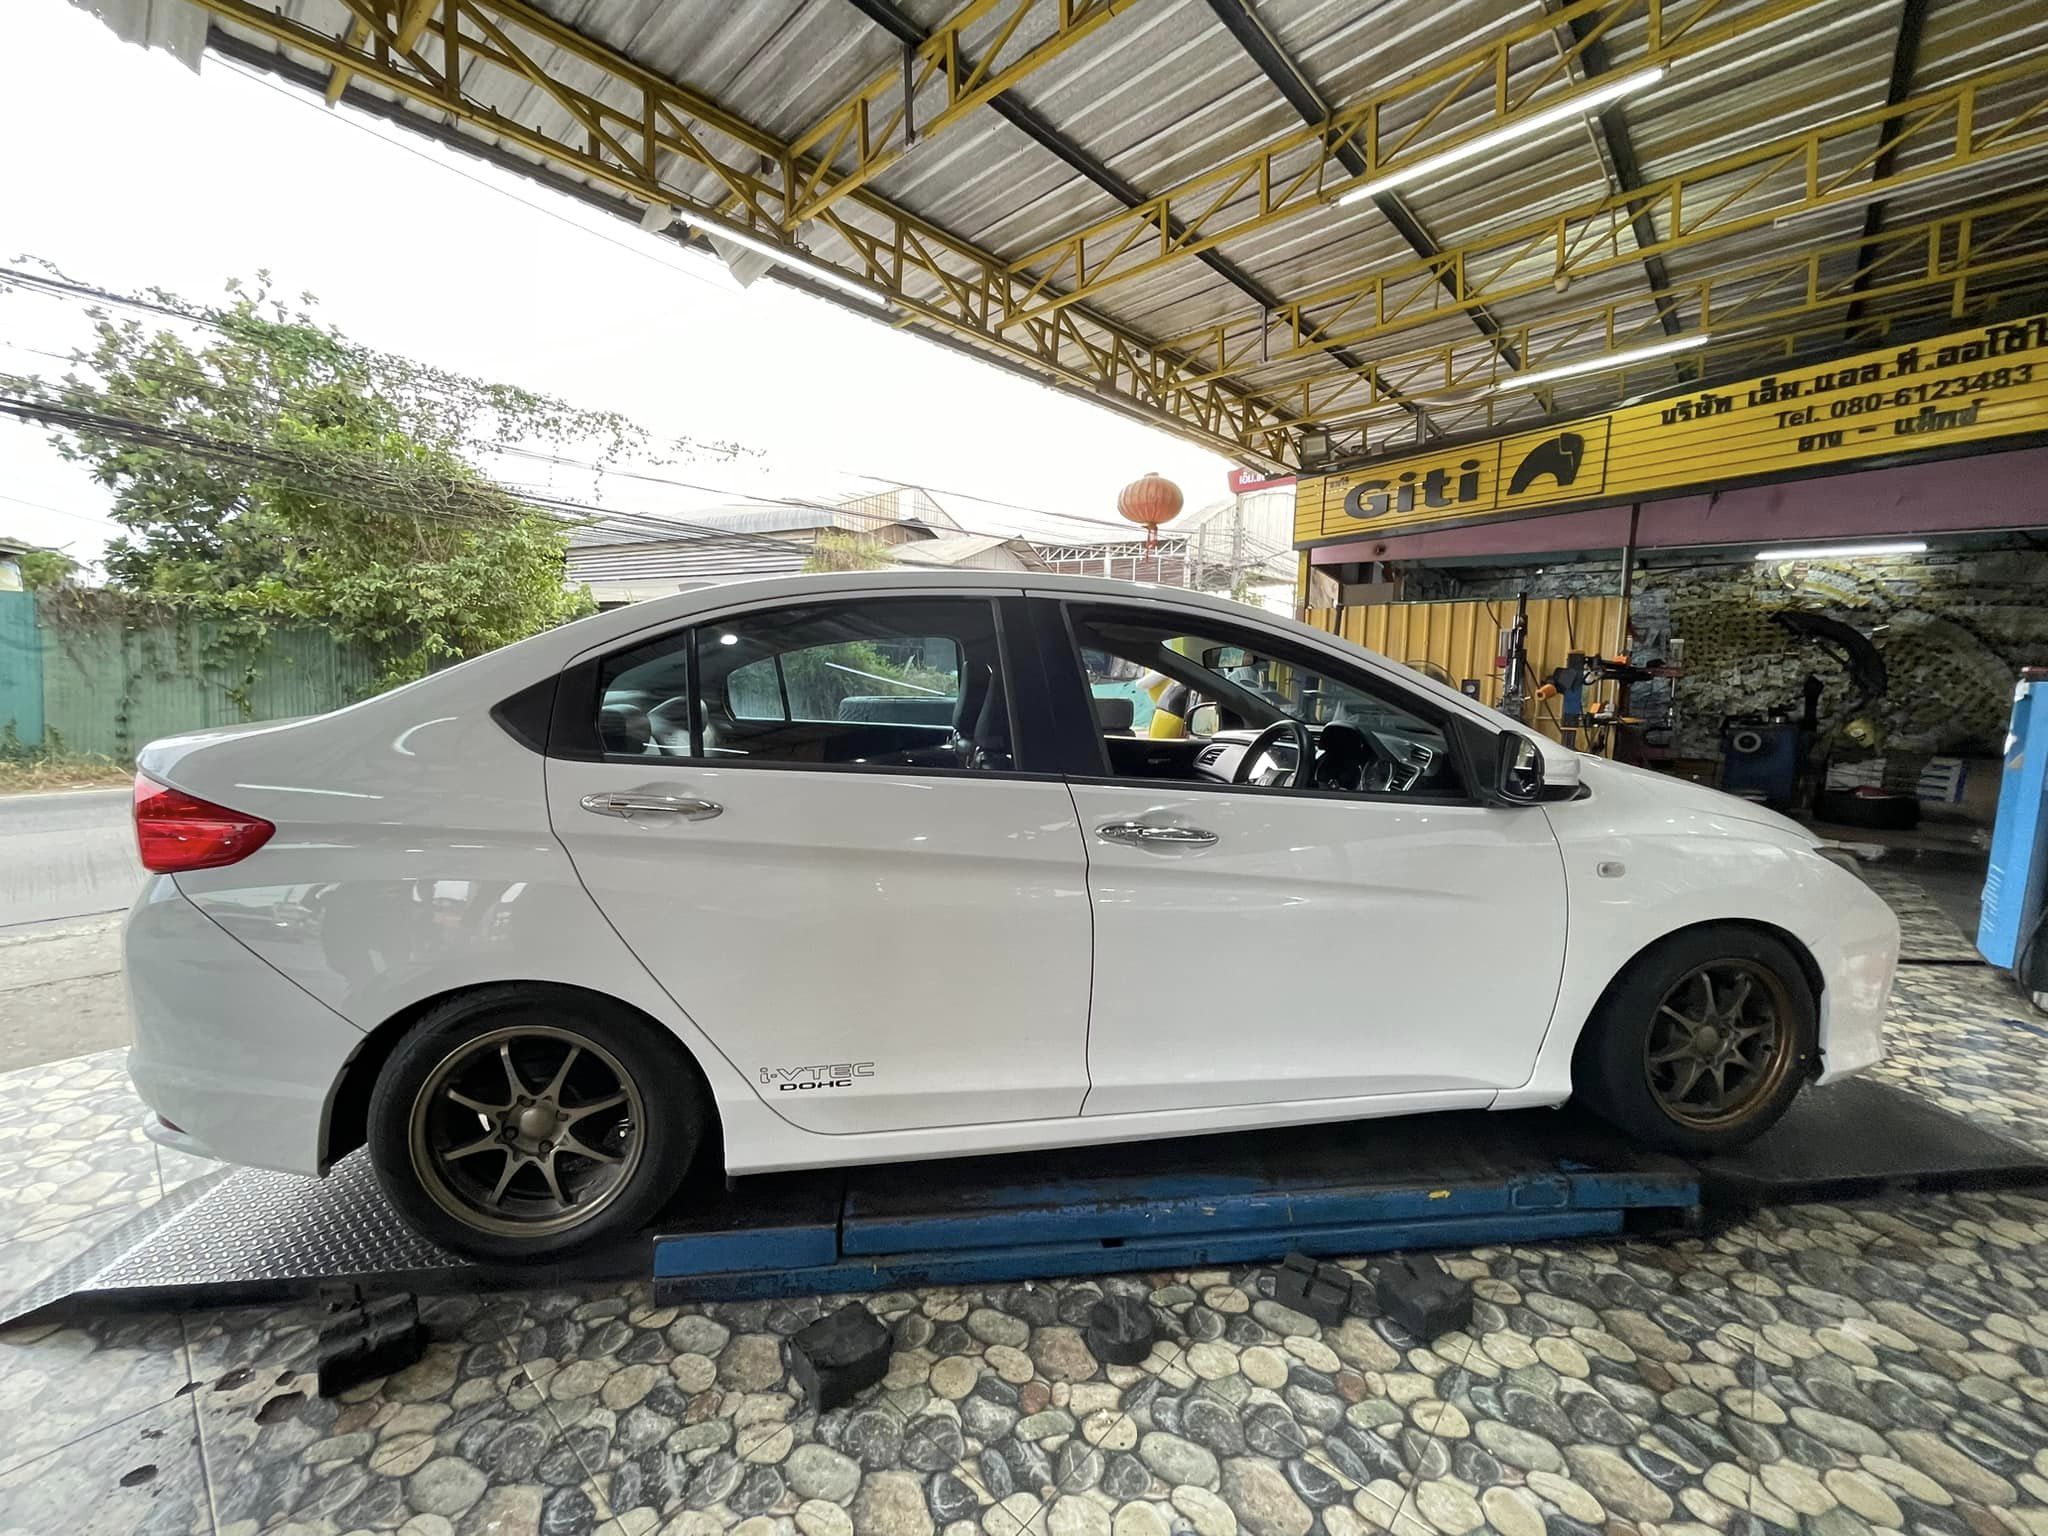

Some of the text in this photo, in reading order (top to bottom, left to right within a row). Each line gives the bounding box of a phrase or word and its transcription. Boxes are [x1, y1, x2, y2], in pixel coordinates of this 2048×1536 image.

[1661, 393, 1733, 425] บริษัท
[1775, 364, 2033, 429] Tel. 080-6123483
[1343, 459, 1481, 519] Giti
[759, 1061, 875, 1084] i-VTEC
[779, 1079, 852, 1091] DOHC
